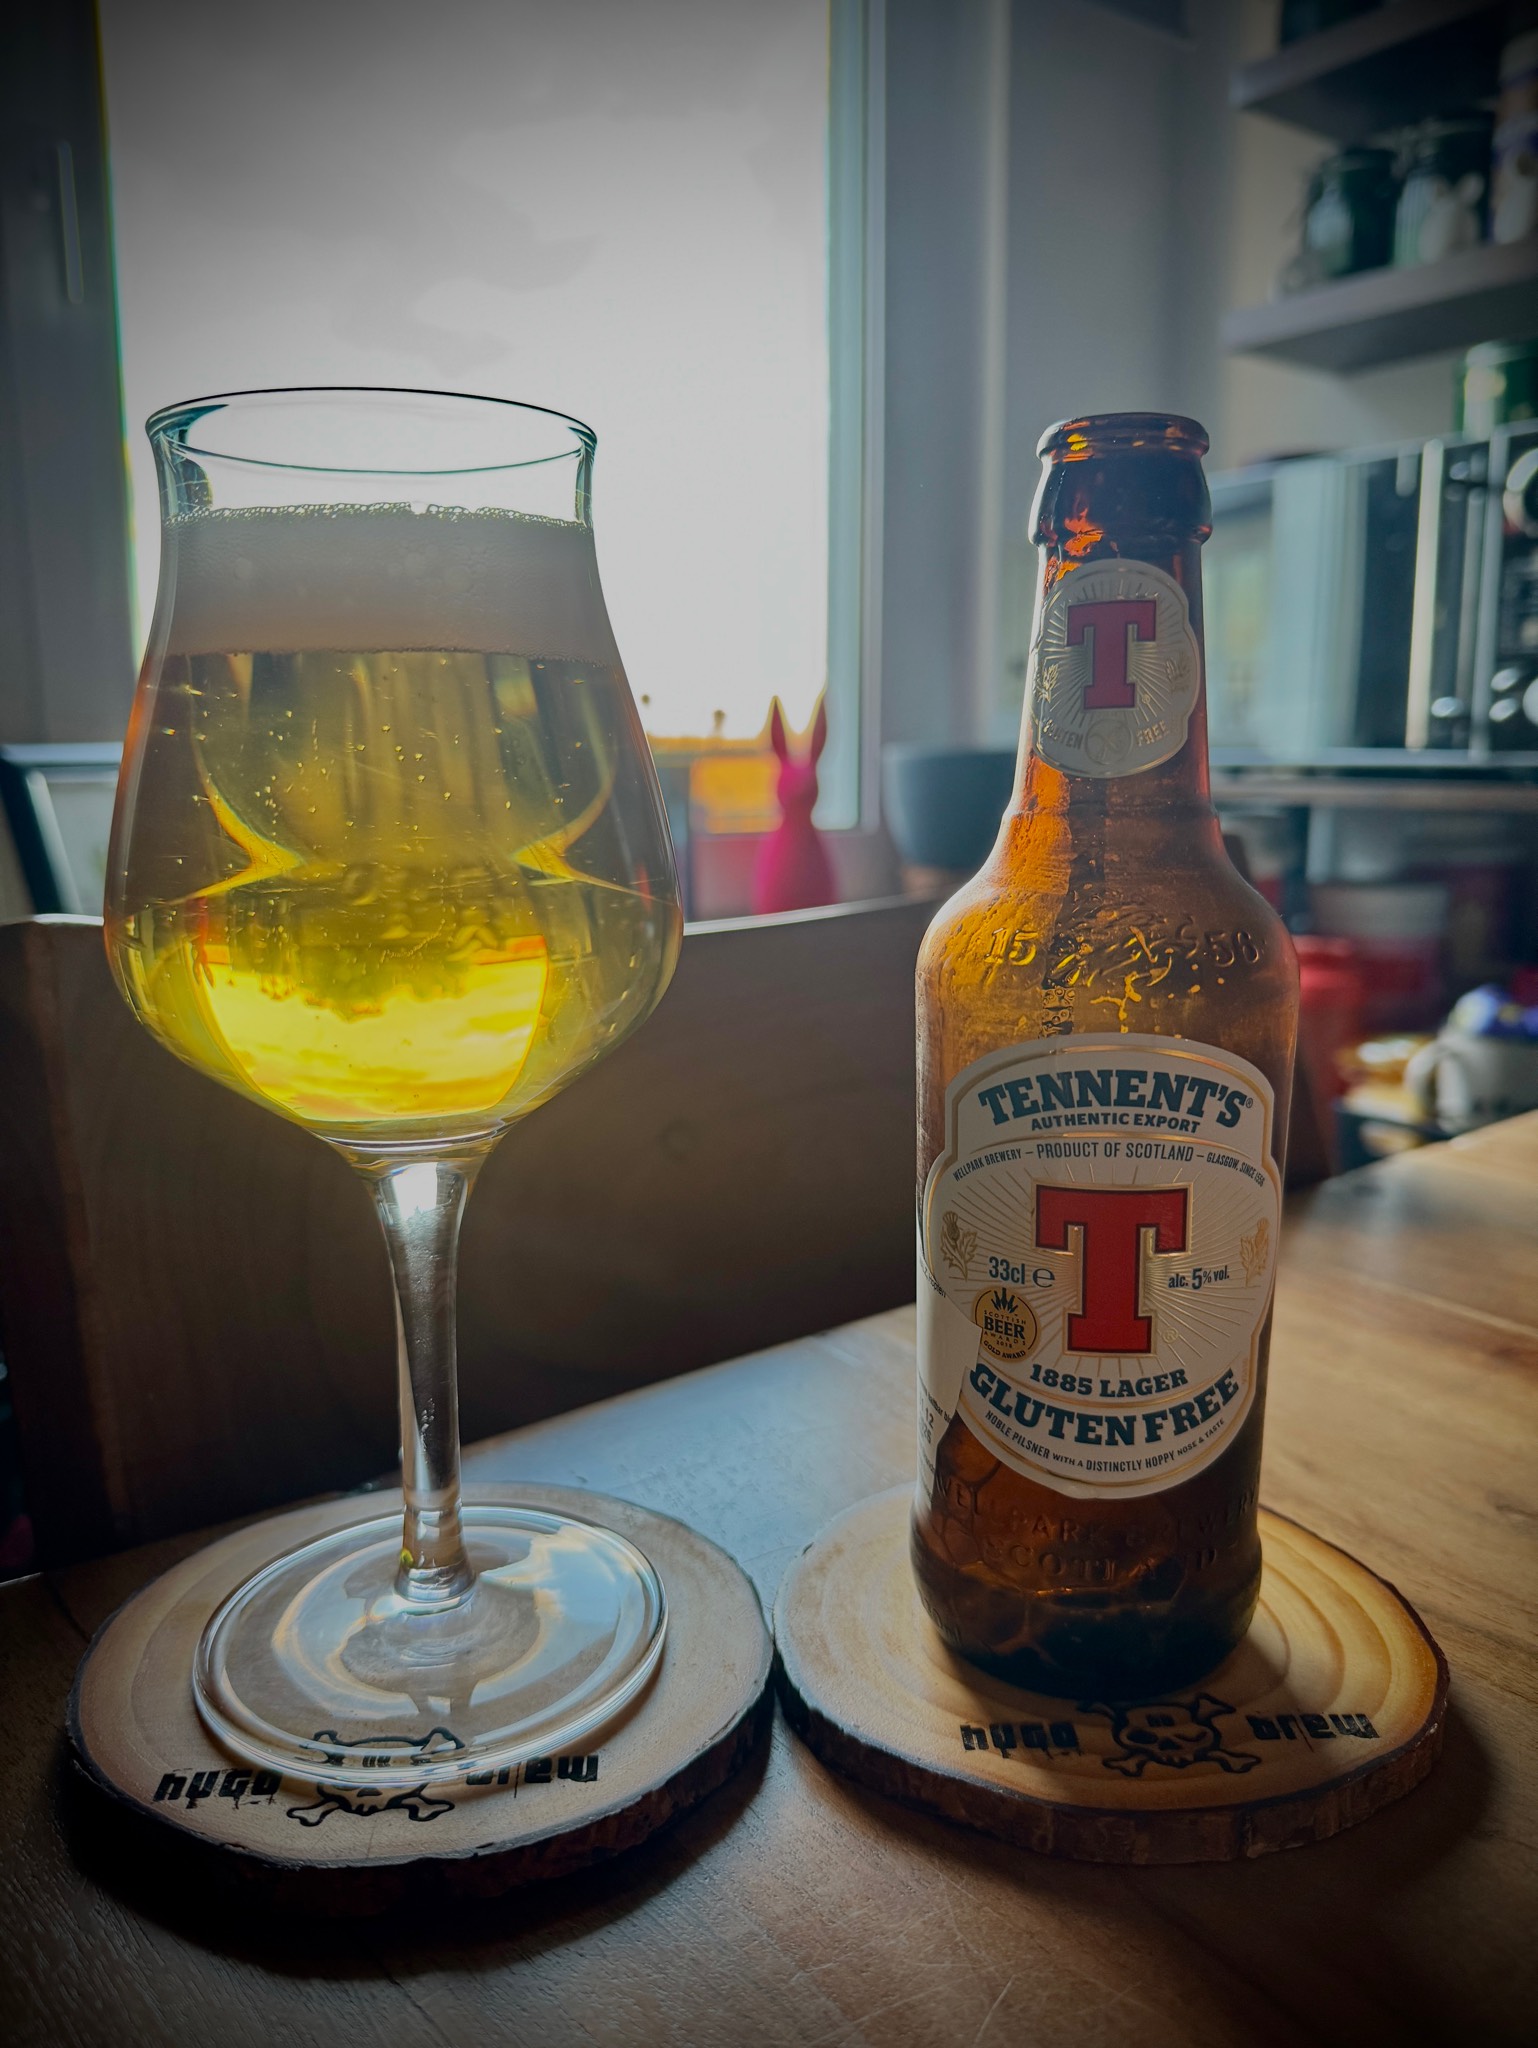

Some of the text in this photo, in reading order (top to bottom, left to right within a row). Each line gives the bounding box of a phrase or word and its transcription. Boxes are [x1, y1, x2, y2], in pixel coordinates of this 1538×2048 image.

[1066, 600, 1157, 710] T
[1031, 1112, 1201, 1134] AUTHENTIC EXPORT
[952, 1156, 986, 1182] WELLPARK
[984, 1148, 1022, 1166] BREWERY
[1036, 1142, 1099, 1160] PRODUCT
[1103, 1142, 1121, 1157] OF
[1125, 1143, 1194, 1163] SCOTLAND
[1206, 1151, 1240, 1172] GLASGOW,
[1239, 1161, 1257, 1179] SINCE
[988, 1255, 1026, 1285] 33cl
[1036, 1183, 1190, 1354] T
[1168, 1272, 1189, 1289] alc.
[1213, 1264, 1230, 1282] vol.
[983, 1309, 1027, 1325] SCOTTISH
[984, 1315, 1026, 1340] BEER
[983, 1331, 1026, 1346] AWARDS
[983, 1340, 1026, 1359] GOLD AWARD
[1029, 1363, 1189, 1398] 1885 LAGER
[969, 1362, 1136, 1446] GLUTEN
[1142, 1367, 1241, 1443] FREE
[985, 1410, 1013, 1437] NOBLE
[1012, 1432, 1050, 1459] PILSNER
[1052, 1452, 1076, 1466] WITH
[1077, 1459, 1084, 1468] A
[1086, 1459, 1142, 1473] DISTINCTLY
[1145, 1450, 1175, 1469] HOPPY
[1177, 1442, 1198, 1456] NOSE
[1204, 1417, 1225, 1439] TASTE
